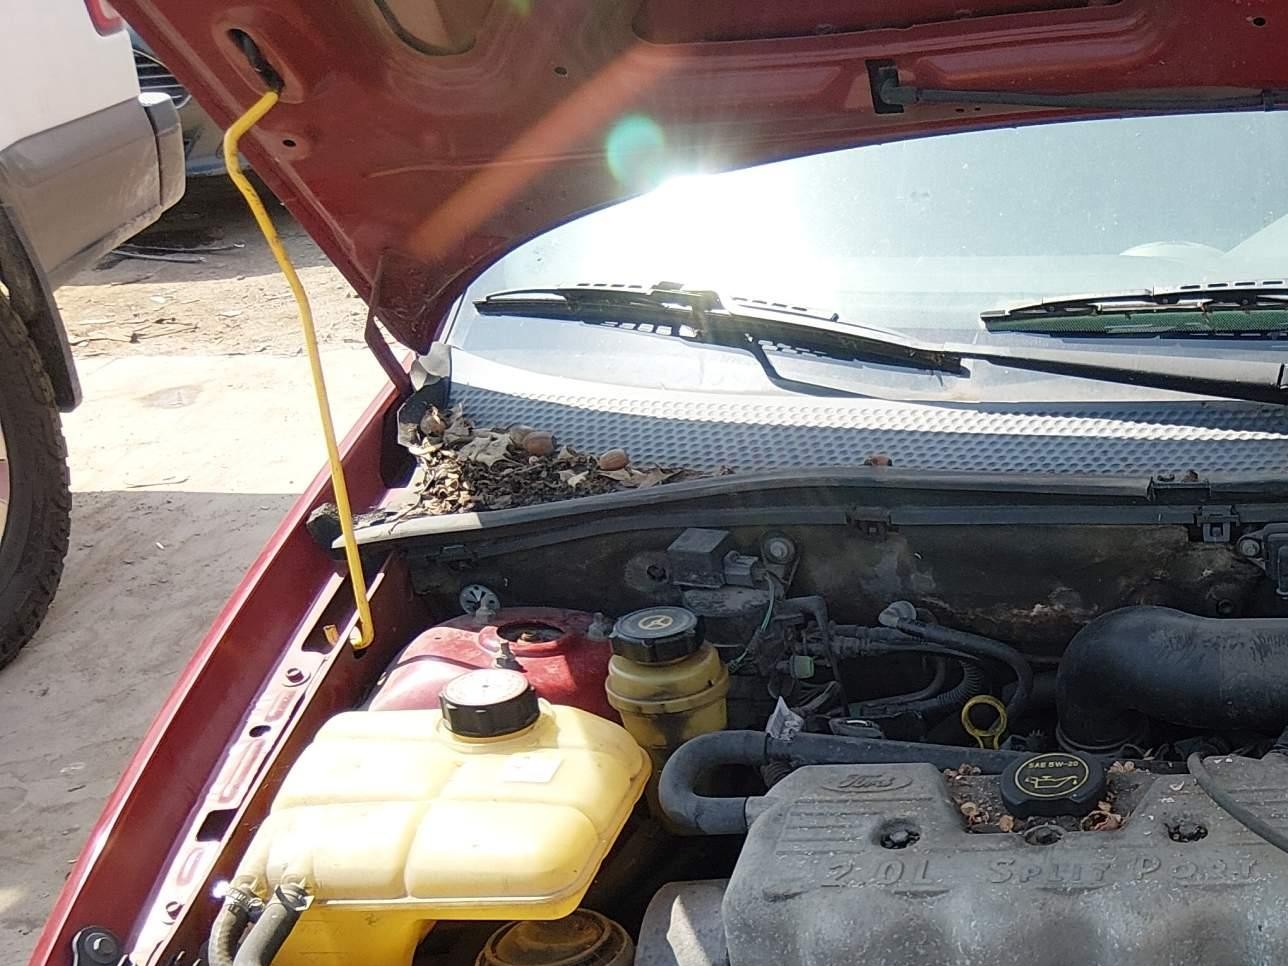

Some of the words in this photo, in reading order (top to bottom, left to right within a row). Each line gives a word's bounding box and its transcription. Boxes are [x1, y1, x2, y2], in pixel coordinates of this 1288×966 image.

[1028, 761, 1047, 769] SAE
[1048, 760, 1079, 768] 5W-20
[821, 858, 934, 888] 2.0L
